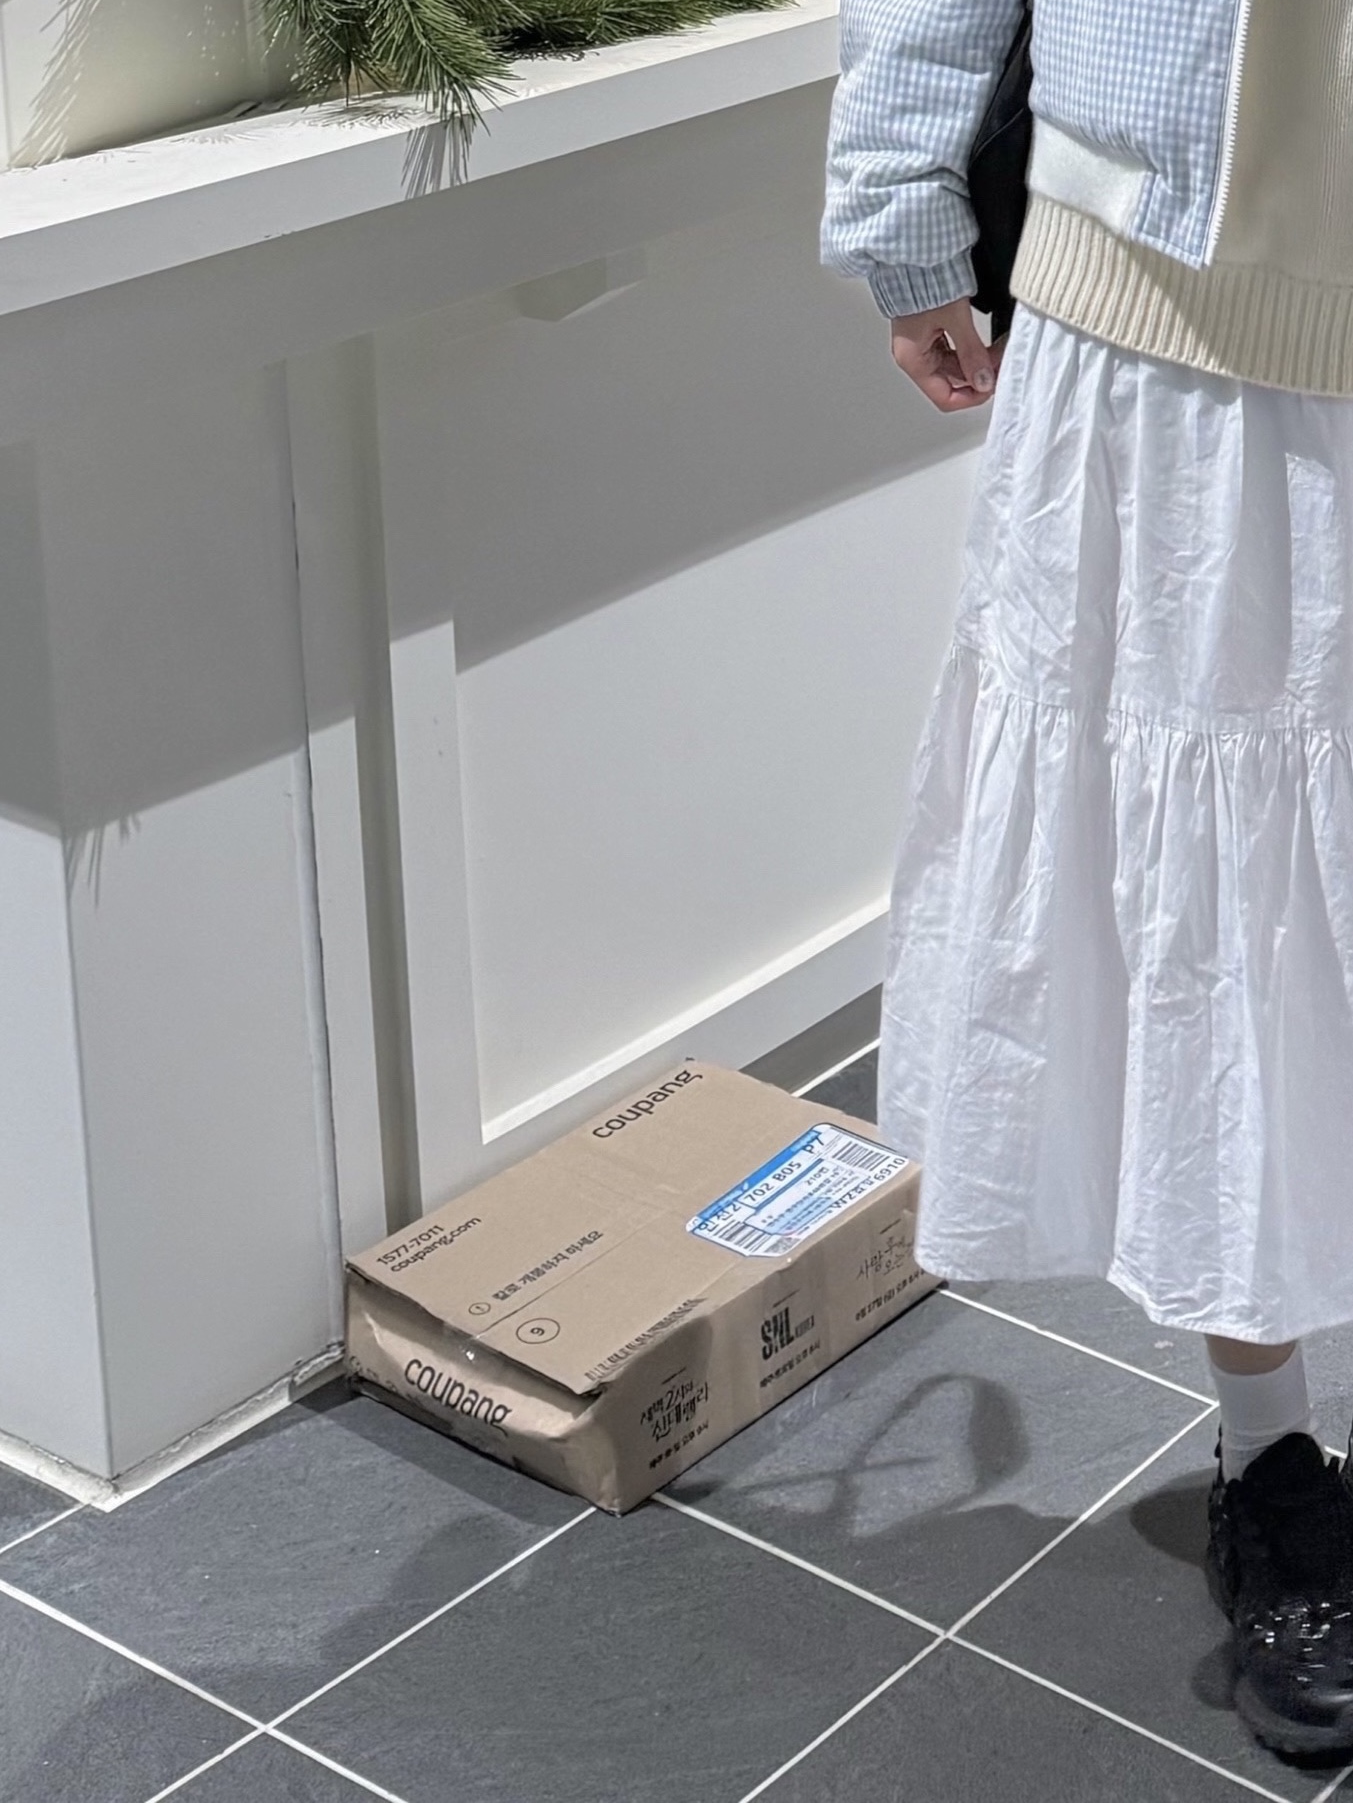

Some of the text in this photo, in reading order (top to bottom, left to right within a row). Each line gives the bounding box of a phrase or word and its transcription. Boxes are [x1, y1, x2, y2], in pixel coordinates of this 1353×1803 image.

[592, 1069, 703, 1140] coupang
[744, 1183, 774, 1202] 702
[772, 1161, 801, 1182] B05
[802, 1132, 826, 1155] P7
[874, 1158, 905, 1181] 6910
[376, 1224, 444, 1266] 1577-7011
[391, 1217, 482, 1272] coupang.com
[404, 1358, 512, 1437] coupang
